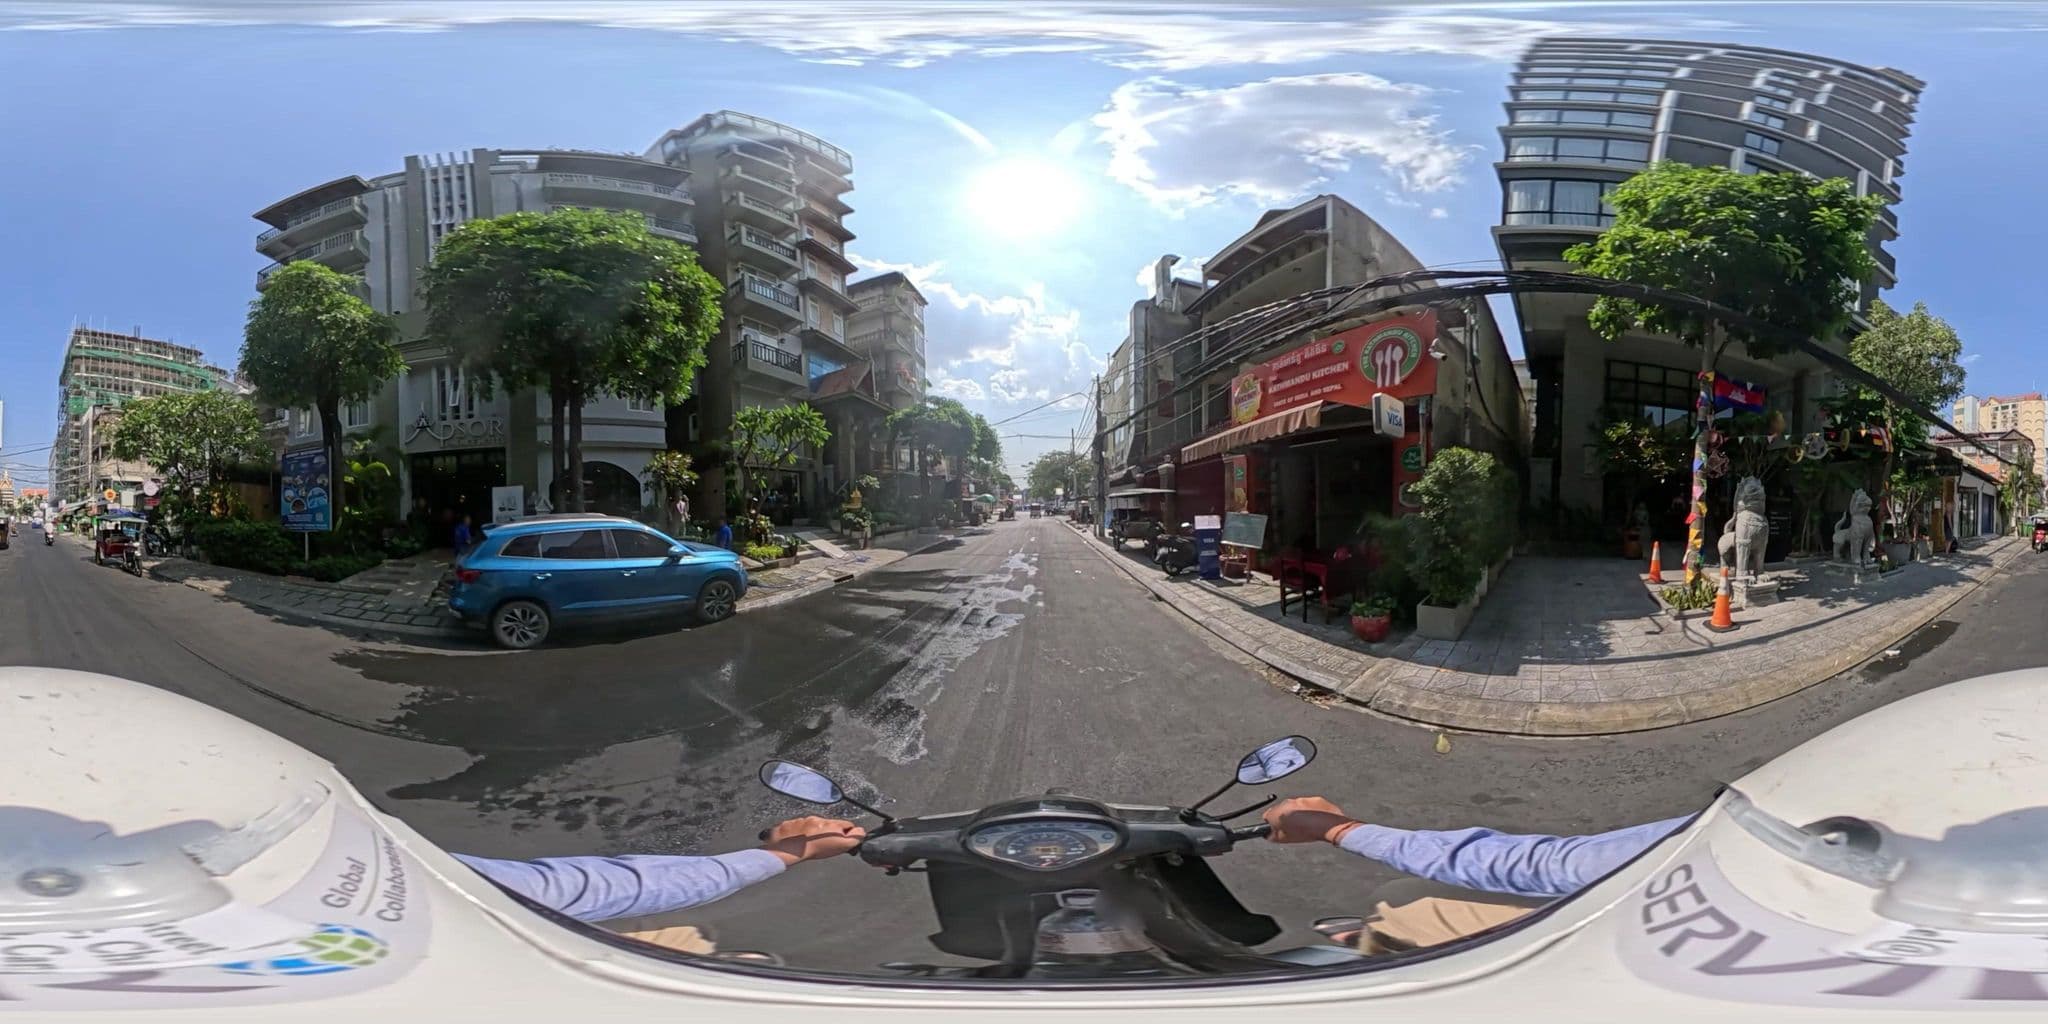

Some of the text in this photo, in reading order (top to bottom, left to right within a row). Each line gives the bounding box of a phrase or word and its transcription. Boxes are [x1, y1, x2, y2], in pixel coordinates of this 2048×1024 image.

[1268, 362, 1349, 394] KATHMANDU KITCHEN
[1387, 411, 1403, 427] VISA
[320, 857, 367, 909] Global
